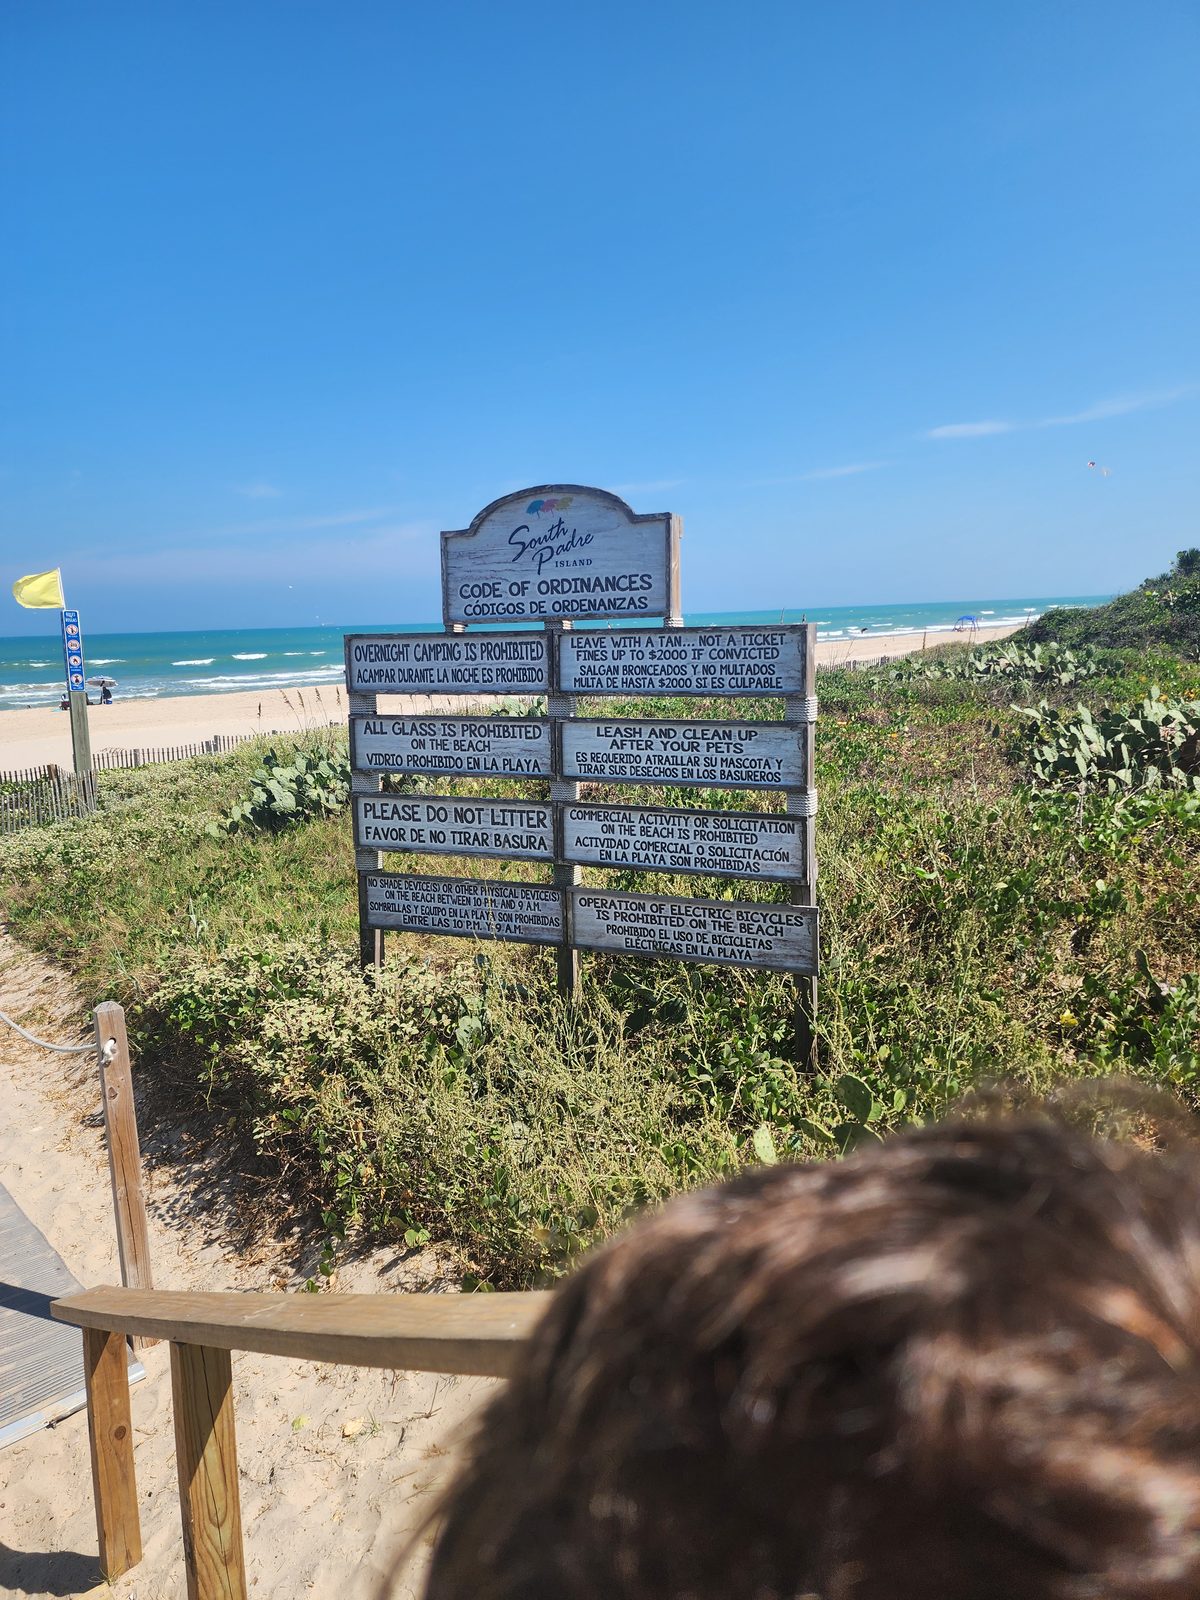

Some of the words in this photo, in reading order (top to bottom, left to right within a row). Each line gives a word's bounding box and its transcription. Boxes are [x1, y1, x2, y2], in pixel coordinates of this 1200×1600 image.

[508, 517, 568, 562] South
[532, 529, 594, 575] Padre
[555, 559, 592, 568] ISLAND
[459, 582, 502, 599] CODE
[509, 581, 530, 596] OF
[537, 574, 652, 595] ORDINANCES
[464, 601, 525, 616] CÓDIGOS
[530, 601, 546, 613] DE
[551, 597, 648, 612] ORDENANZAS
[570, 637, 606, 648] LEAVE
[611, 637, 639, 648] WITH
[646, 637, 653, 647] A
[658, 637, 695, 647] TAN...
[699, 634, 722, 647] NOT
[727, 635, 736, 646] A
[741, 633, 786, 645] TICKET
[355, 643, 410, 662] OVERNIGHT
[414, 642, 461, 662] CAMPING
[464, 642, 477, 661] IS
[481, 641, 543, 661] PROHIBITED
[576, 650, 607, 661] FINES
[612, 650, 625, 660] UP
[631, 650, 644, 660] TO
[649, 649, 688, 660] $2000
[691, 649, 703, 660] IF
[709, 648, 779, 660] CONVICTED
[357, 668, 395, 683] ACAMPAR
[398, 668, 434, 683] DURANTE
[437, 668, 449, 682] LA
[452, 668, 479, 682] NOCHE
[482, 668, 493, 682] ES
[496, 667, 544, 682] PROHIBIDO
[580, 665, 620, 676] SALGAN
[623, 665, 688, 676] BRONCEADOS
[692, 664, 700, 675] Y
[702, 665, 716, 675] NO
[720, 664, 775, 675] MULTADOS
[574, 677, 603, 688] MULTA
[606, 678, 618, 688] DE
[621, 678, 655, 688] HASTA
[658, 678, 692, 688] $2000
[696, 678, 708, 688] SI
[711, 678, 724, 688] ES
[729, 678, 783, 688] CULPABLE
[364, 721, 387, 735] ALL
[392, 722, 436, 736] GLASS
[441, 723, 456, 737] IS
[462, 724, 541, 739] PROHIBITED
[596, 727, 642, 738] LEASH
[648, 728, 677, 739] AND
[682, 729, 732, 740] CLEAN
[738, 730, 758, 741] UP
[411, 739, 426, 749] ON
[429, 739, 449, 751] THE
[453, 739, 491, 752] BEACH
[610, 739, 654, 751] AFTER
[660, 740, 700, 752] YOUR
[706, 742, 743, 754] PETS
[366, 753, 403, 766] VIDRIO
[407, 755, 463, 769] PROHIBIDO
[467, 757, 480, 770] EN
[484, 758, 498, 770] LA
[502, 758, 541, 772] PLAYA
[576, 752, 588, 762] ES
[590, 753, 641, 764] REQUERIDO
[645, 755, 700, 767] ATRAILLAR
[703, 757, 717, 767] SU
[720, 757, 770, 769] MASCOTA
[775, 759, 783, 770] Y
[578, 764, 607, 774] TIRAR
[609, 765, 627, 775] SUS
[630, 766, 678, 778] DESECHOS
[682, 768, 694, 779] EN
[697, 769, 716, 780] LOS
[720, 770, 781, 782] BASUREROS
[364, 803, 421, 822] PLEASE
[426, 805, 448, 822] DO
[454, 808, 484, 824] NOT
[491, 809, 547, 828] LITTER
[570, 809, 635, 823] COMMERCIAL
[638, 814, 689, 826] ACTIVITY
[694, 817, 709, 828] OR
[713, 818, 795, 834] SOLICITATION
[365, 826, 406, 841] FAVOR
[411, 828, 425, 843] DE
[430, 830, 446, 843] NO
[450, 831, 489, 847] TIRAR
[494, 834, 547, 850] BASURA
[601, 824, 614, 834] ON
[619, 825, 636, 836] THE
[640, 826, 674, 838] BEACH
[678, 829, 689, 839] IS
[693, 830, 758, 844] PROHIBITED
[575, 836, 630, 849] ACTIVIDAD
[633, 841, 692, 854] COMERCIAL
[696, 845, 704, 855] O
[708, 846, 790, 862] SOLICITACIÓN
[600, 850, 612, 860] EN
[615, 851, 628, 862] LA
[632, 853, 666, 865] PLAYA
[670, 856, 691, 867] SON
[694, 858, 761, 873] PROHIBIDAS
[368, 879, 377, 887] NO
[380, 879, 402, 889] SHADE
[405, 881, 440, 892] DEVICE(S)
[443, 884, 452, 893] OR
[455, 885, 478, 895] OTHER
[481, 885, 519, 898] PHYSICAL
[521, 889, 560, 901] DEVICE(S)
[385, 891, 394, 899] ON
[397, 891, 409, 900] THE
[412, 892, 435, 903] BEACH
[438, 894, 470, 905] BETWEEN
[474, 898, 482, 907] 10
[501, 900, 515, 909] AND
[518, 901, 523, 910] 9
[526, 901, 541, 911] A.M.
[370, 902, 411, 913] SOMBRILLAS
[413, 905, 419, 914] Y
[421, 906, 446, 916] EQUIPO
[449, 908, 457, 917] EN
[459, 909, 469, 918] LA
[498, 913, 512, 922] SON
[515, 914, 560, 927] PROHIBIDAS
[579, 898, 645, 912] OPERATION
[650, 903, 666, 915] OF
[671, 905, 732, 920] ELECTRIC
[736, 910, 804, 927] BICYCLES
[403, 915, 429, 926] ENTRE
[432, 917, 450, 928] LAS
[453, 919, 463, 928] 10
[466, 921, 482, 930] P.M.
[486, 922, 492, 931] Y
[496, 924, 501, 932] 9
[505, 924, 523, 934] A.M.
[596, 910, 609, 920] IS
[614, 912, 684, 927] PROHIBITED
[689, 919, 706, 929] ON
[711, 920, 735, 933] THE
[739, 923, 784, 937] BEACH
[606, 925, 655, 938] PROHIBIDO
[659, 931, 671, 940] EL
[673, 932, 693, 942] USO
[696, 933, 709, 944] DE
[712, 934, 773, 950] BICICLETAS
[625, 936, 682, 953] ELÉCTRICAS
[686, 944, 698, 954] EN
[701, 946, 715, 957] LA
[718, 947, 752, 961] PLAYA
